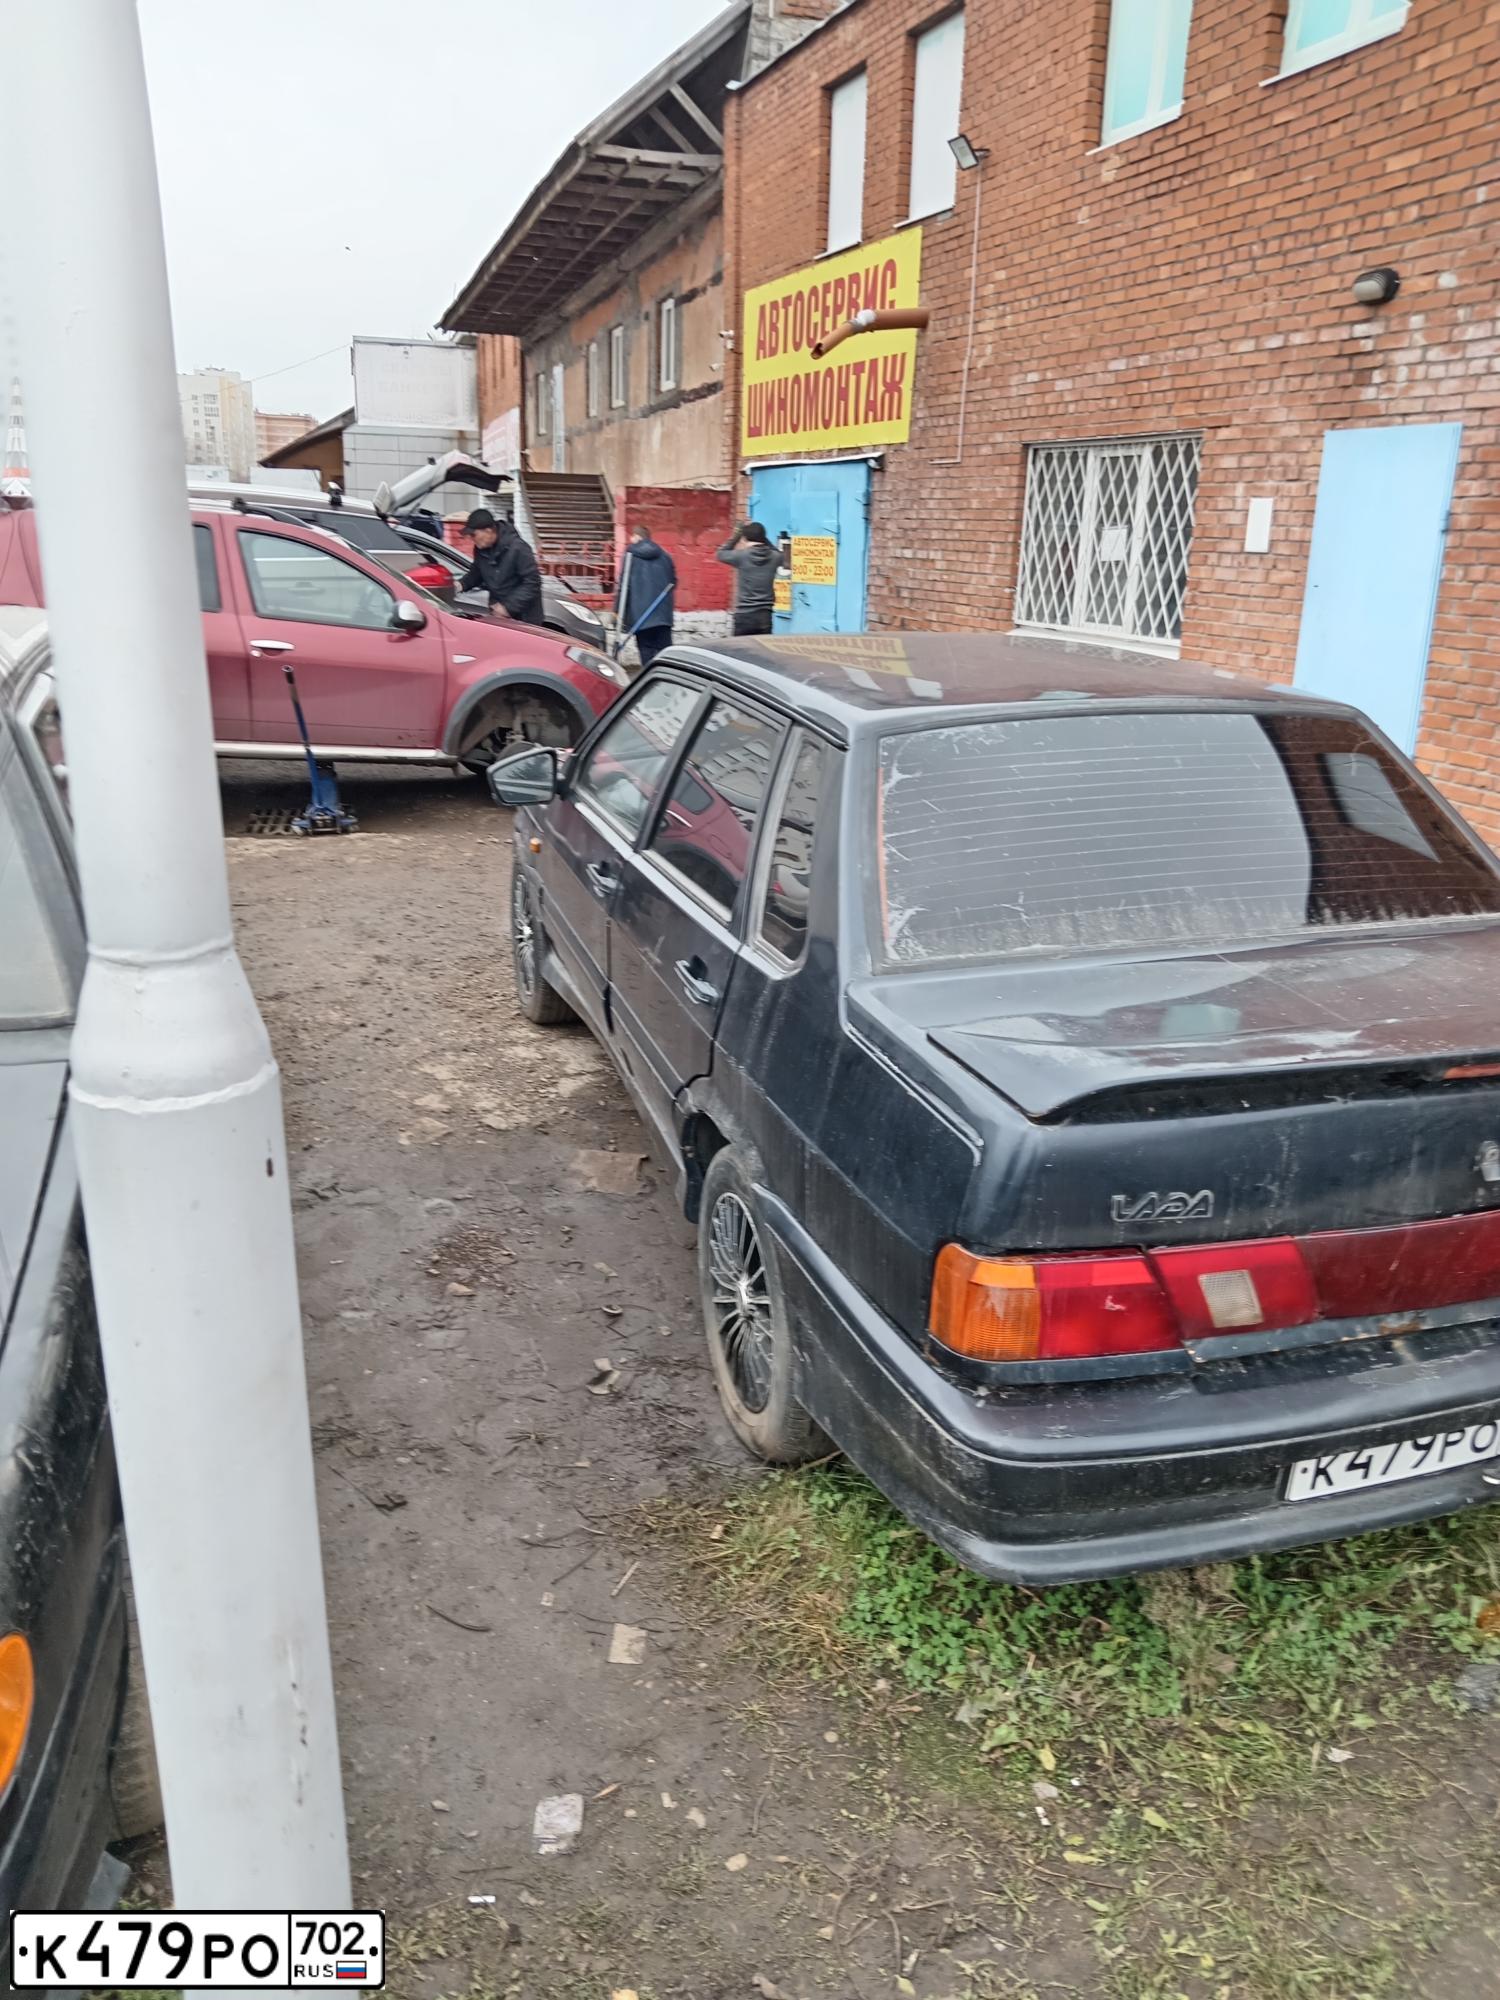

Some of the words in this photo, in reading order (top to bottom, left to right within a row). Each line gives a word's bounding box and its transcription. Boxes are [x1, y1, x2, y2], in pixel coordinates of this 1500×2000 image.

[756, 258, 897, 361] АВТОСЕРВИС
[747, 352, 907, 438] ШИНОМОНТАЖ
[1110, 1190, 1215, 1222] LADA
